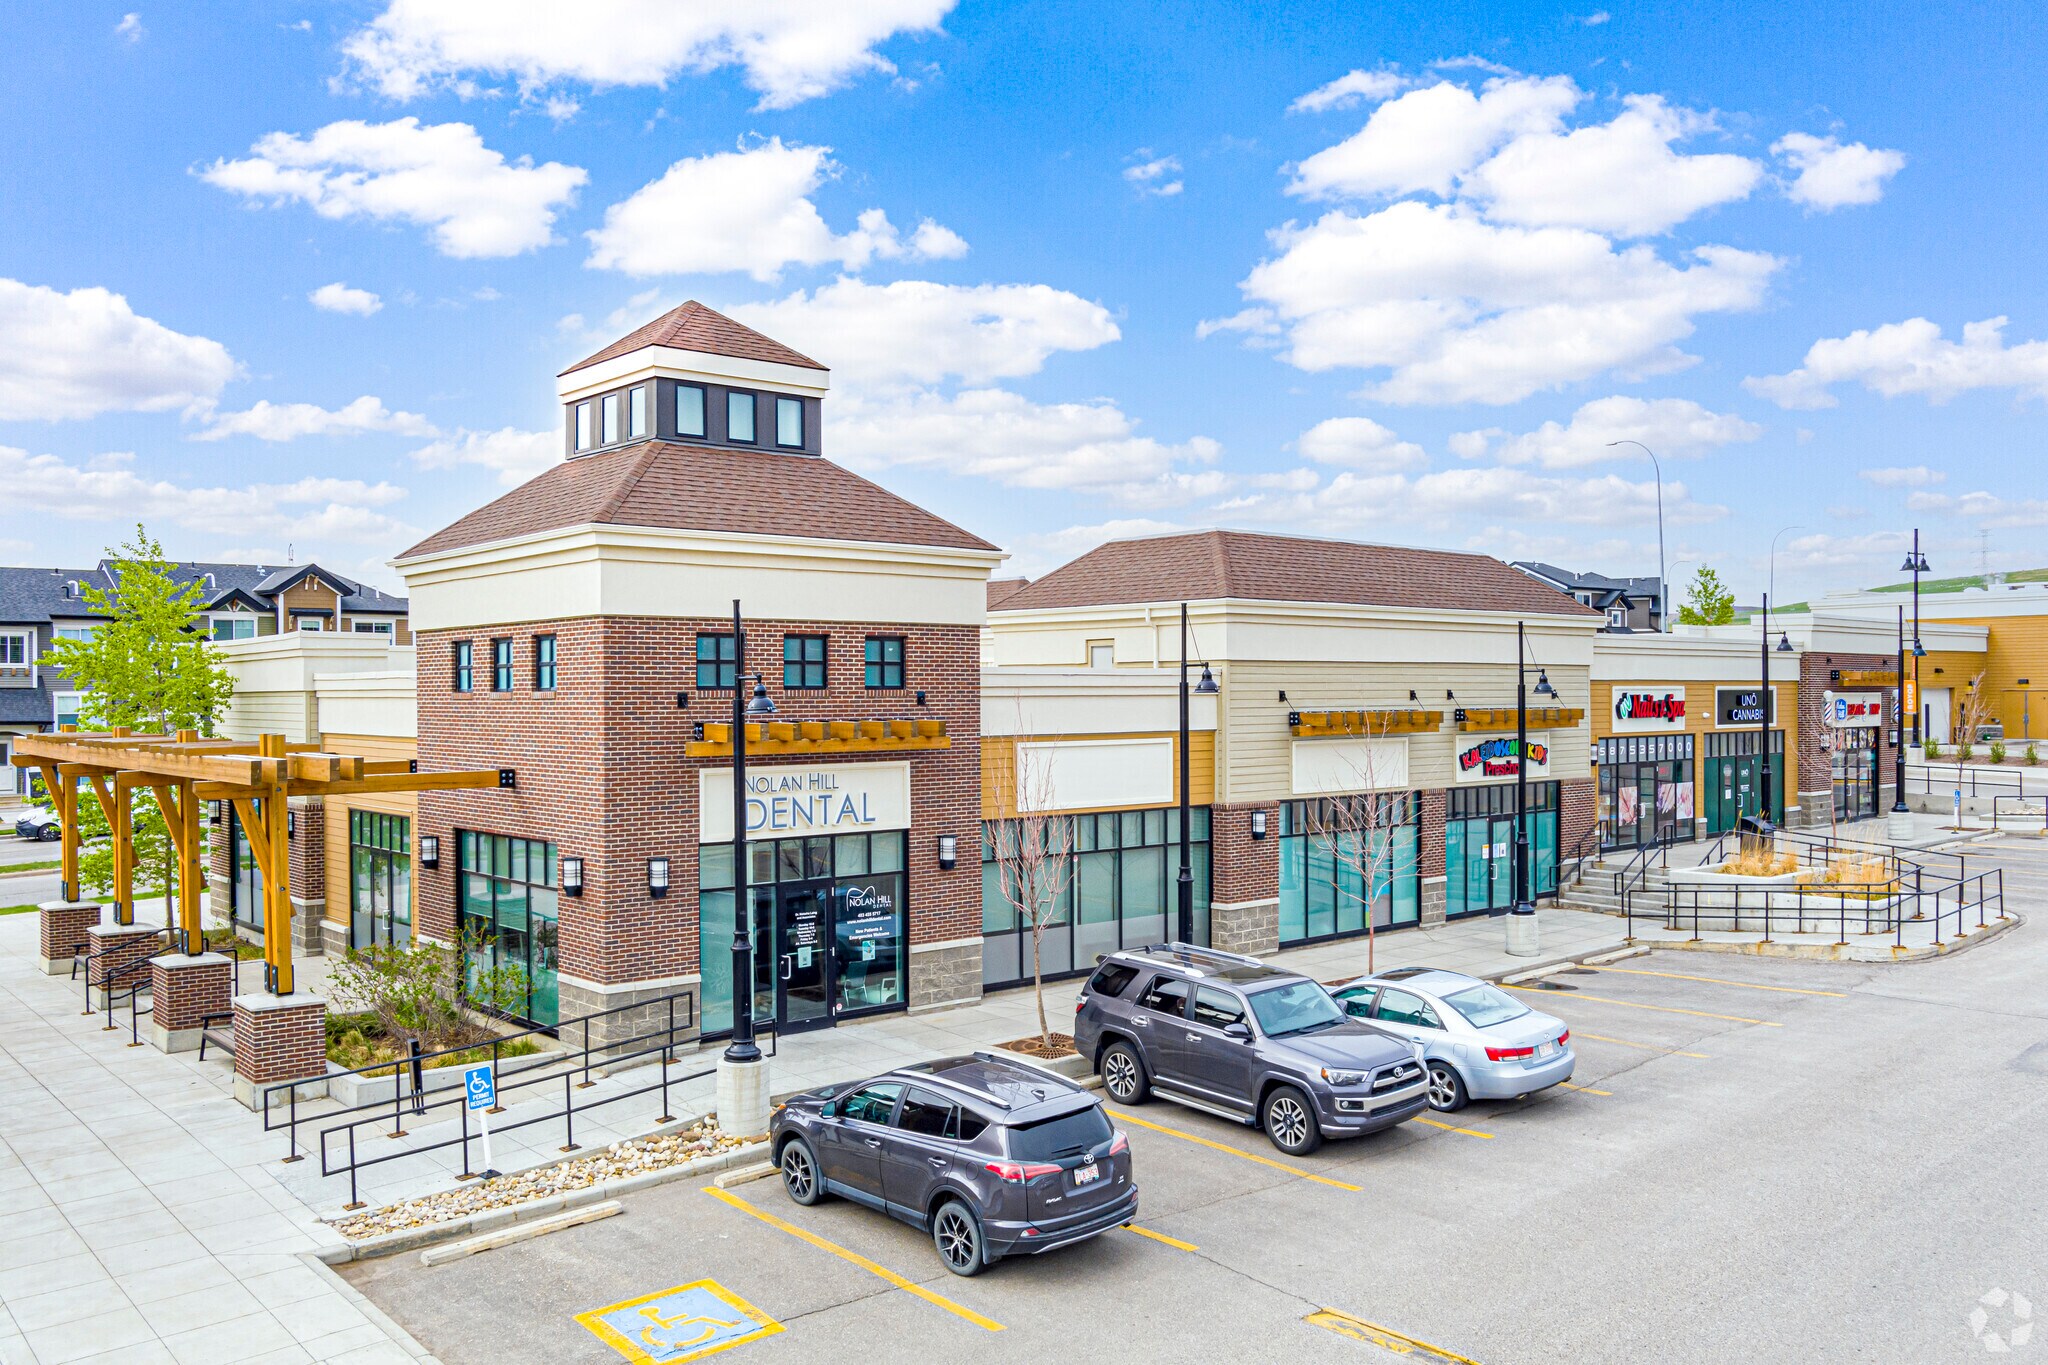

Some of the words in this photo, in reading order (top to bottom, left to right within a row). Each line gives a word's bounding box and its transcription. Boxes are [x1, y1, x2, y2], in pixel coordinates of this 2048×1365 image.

[1631, 694, 1659, 718] Nails
[1667, 693, 1686, 722] Spa
[1462, 740, 1519, 769] KALEIDOSCO
[1485, 760, 1519, 776] Prescho
[745, 775, 802, 794] NOLAN
[745, 792, 876, 831] DENTAL
[849, 897, 875, 907] NOLAN
[473, 1092, 489, 1100] PERMIT
